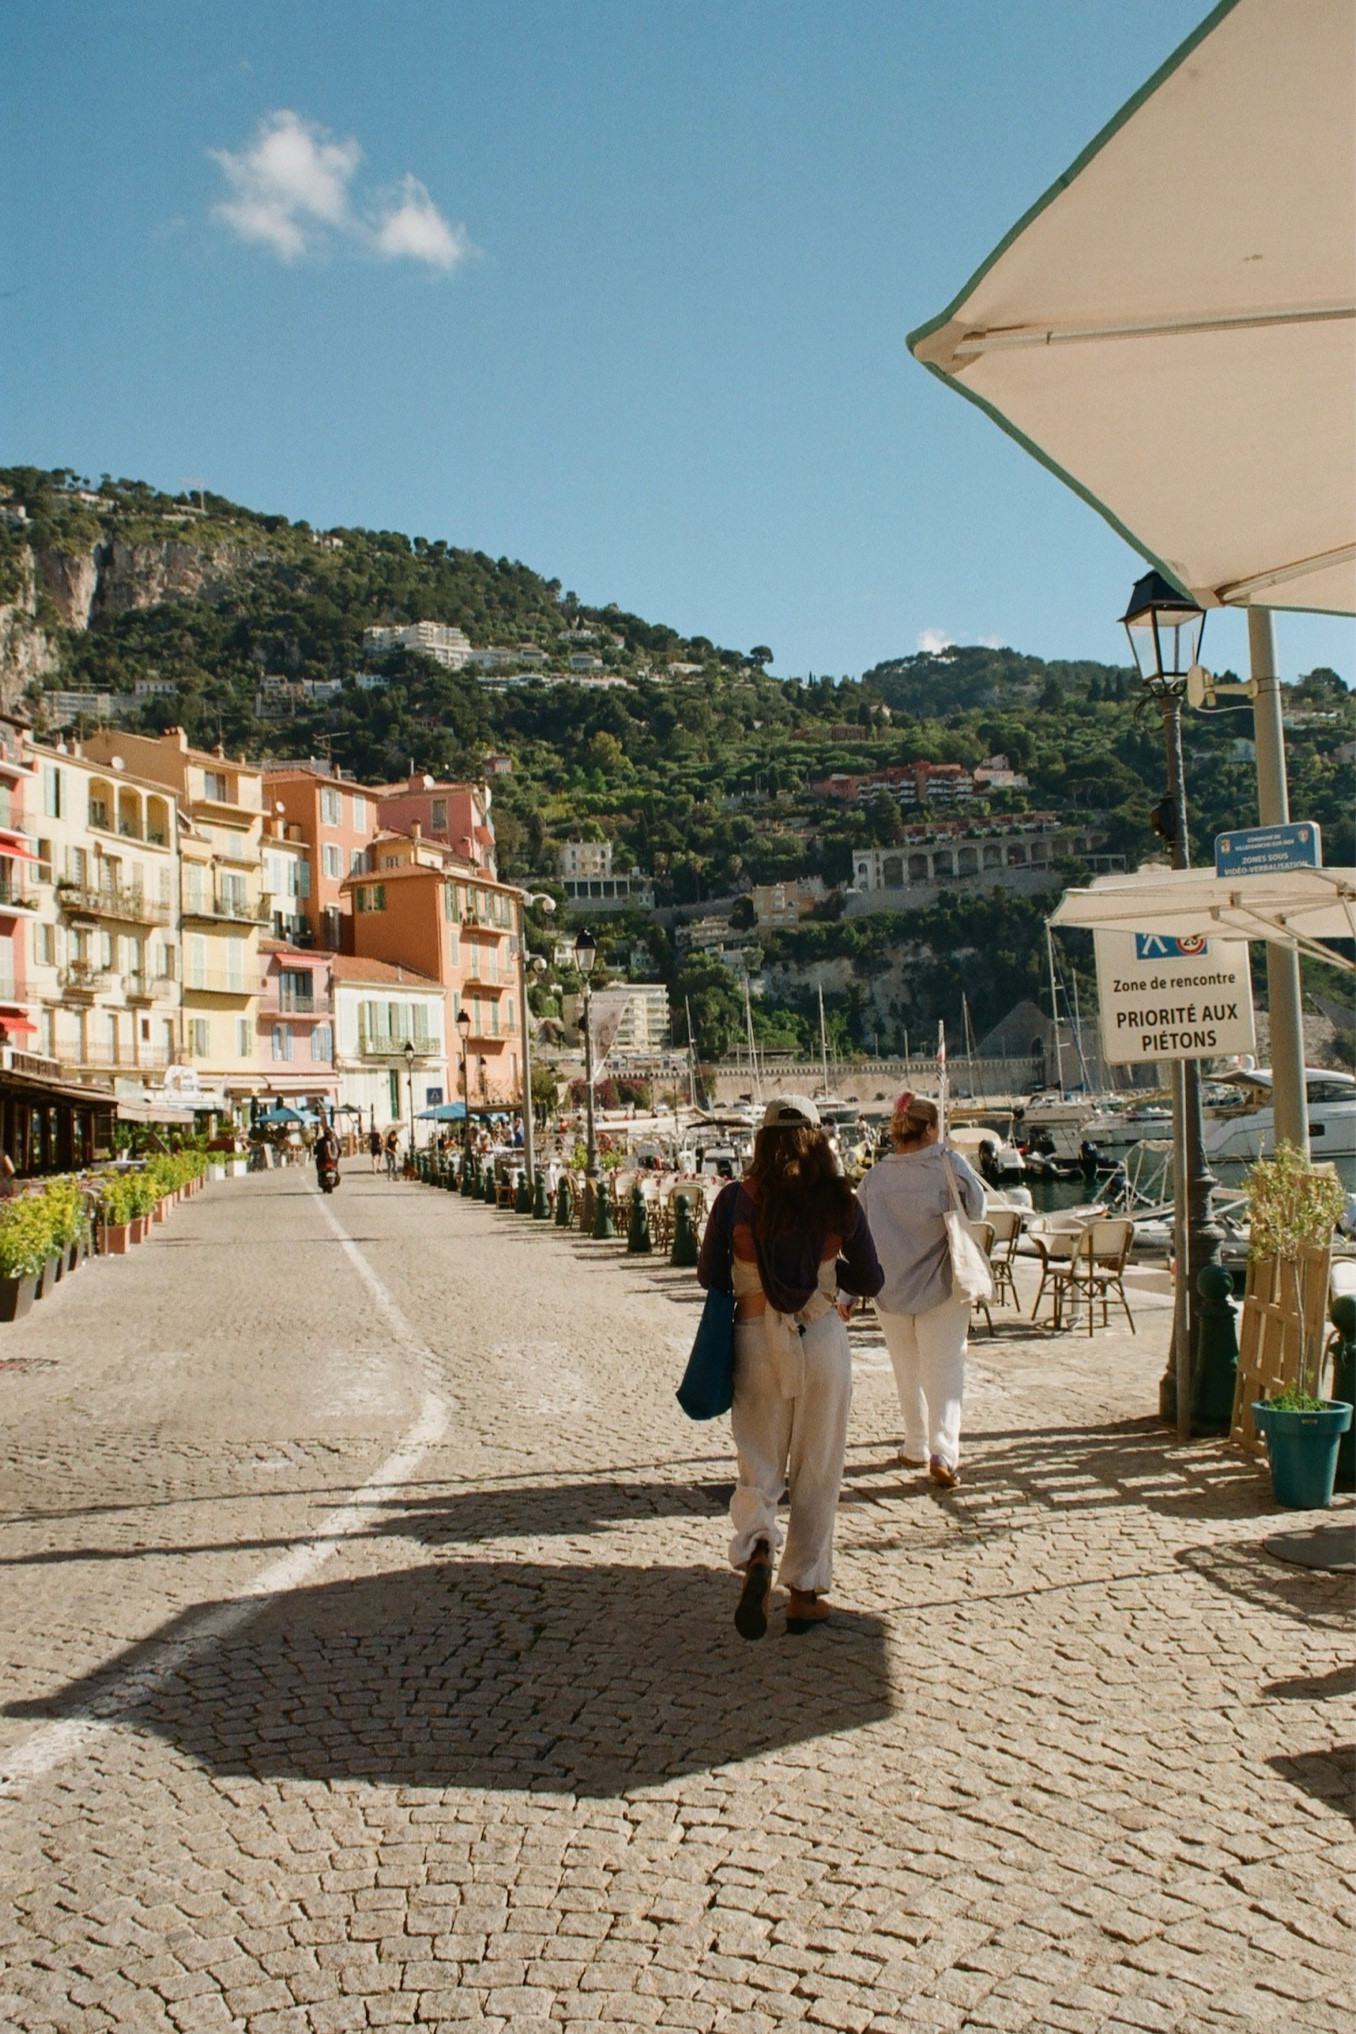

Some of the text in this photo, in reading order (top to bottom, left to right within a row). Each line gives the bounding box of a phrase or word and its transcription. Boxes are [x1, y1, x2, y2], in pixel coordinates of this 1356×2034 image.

[1242, 852, 1289, 865] ZONES SOUS
[1113, 972, 1235, 993] Zone de rencontre
[1117, 1003, 1238, 1028] PRIORITÉ AUX
[1142, 1030, 1217, 1051] PIÉTONS
